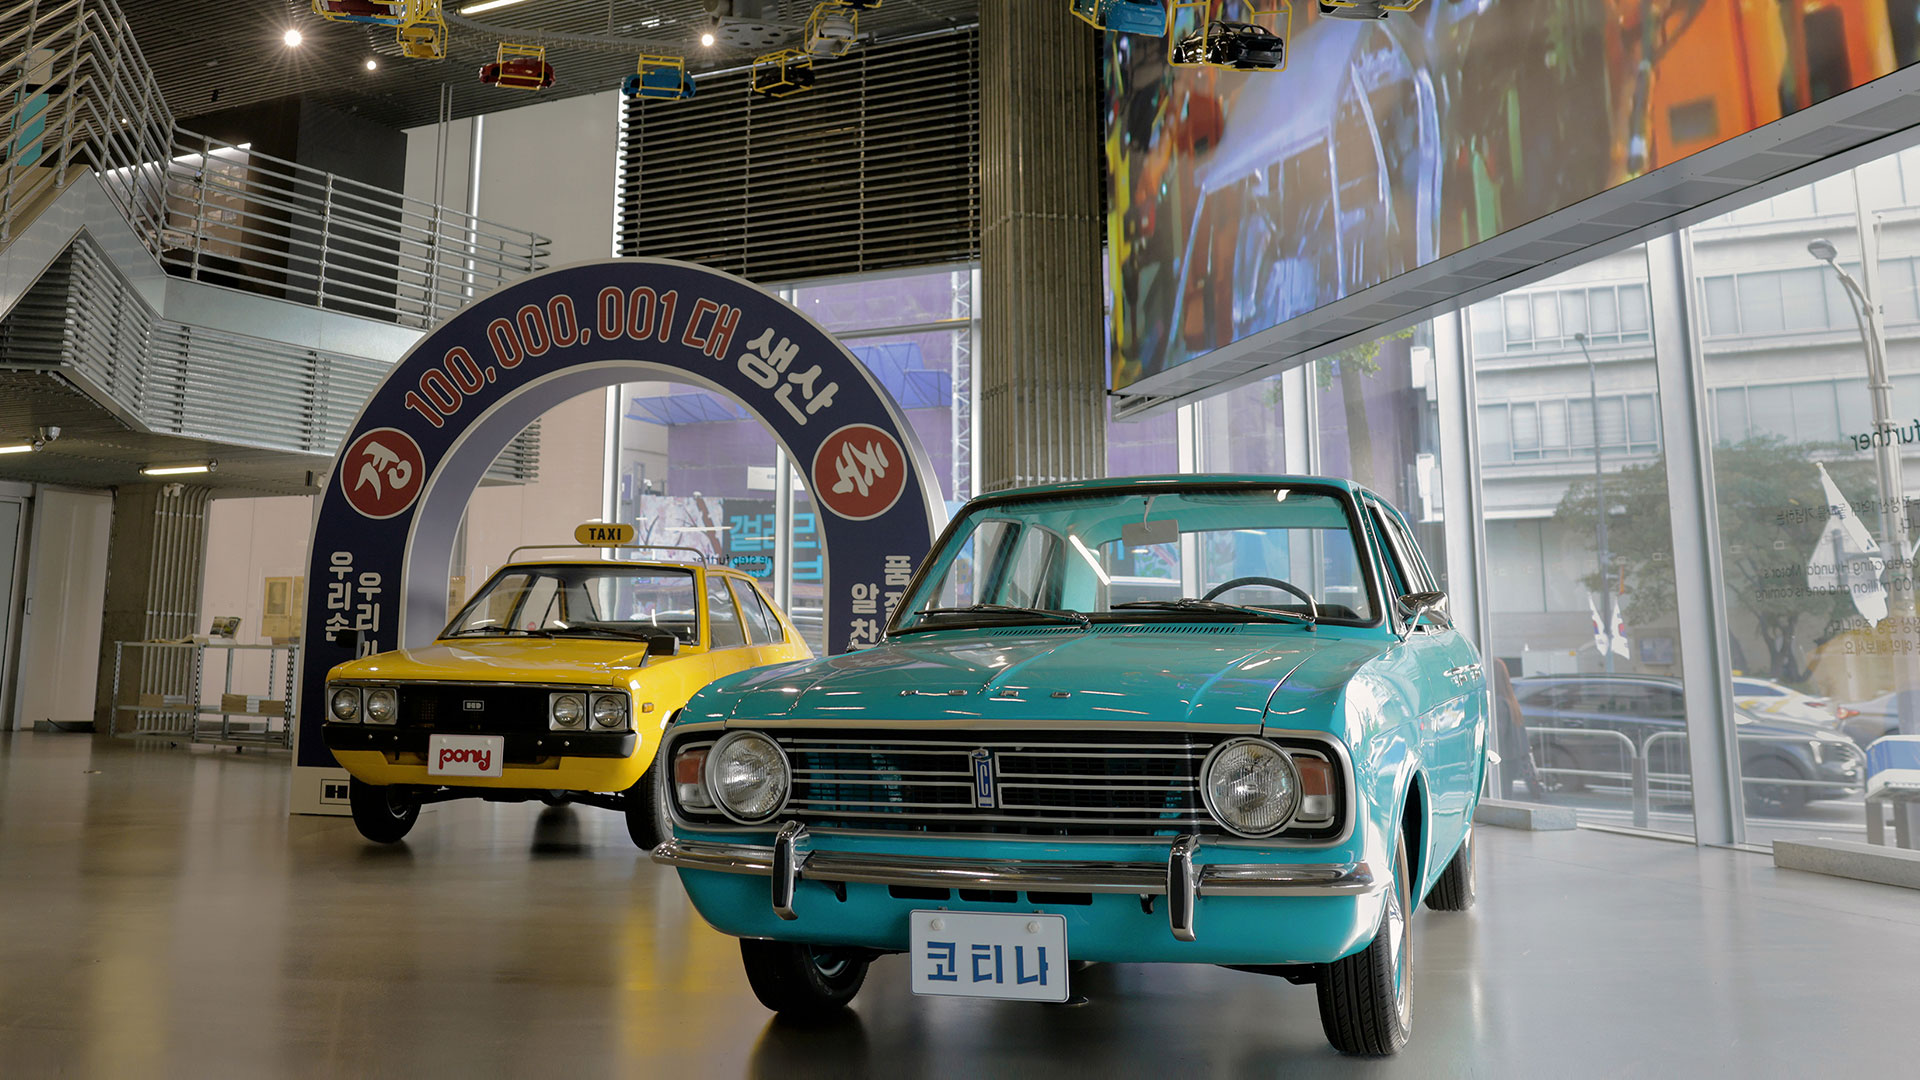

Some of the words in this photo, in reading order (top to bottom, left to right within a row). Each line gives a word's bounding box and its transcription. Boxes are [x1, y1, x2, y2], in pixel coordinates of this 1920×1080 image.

[404, 286, 678, 428] 100,000,001
[737, 327, 839, 426] 생산
[354, 441, 413, 500] 경
[832, 440, 889, 497] 축
[588, 527, 622, 541] TAXI
[850, 582, 880, 650] 알찬
[438, 748, 491, 771] pony
[927, 941, 1049, 986] 코티나
